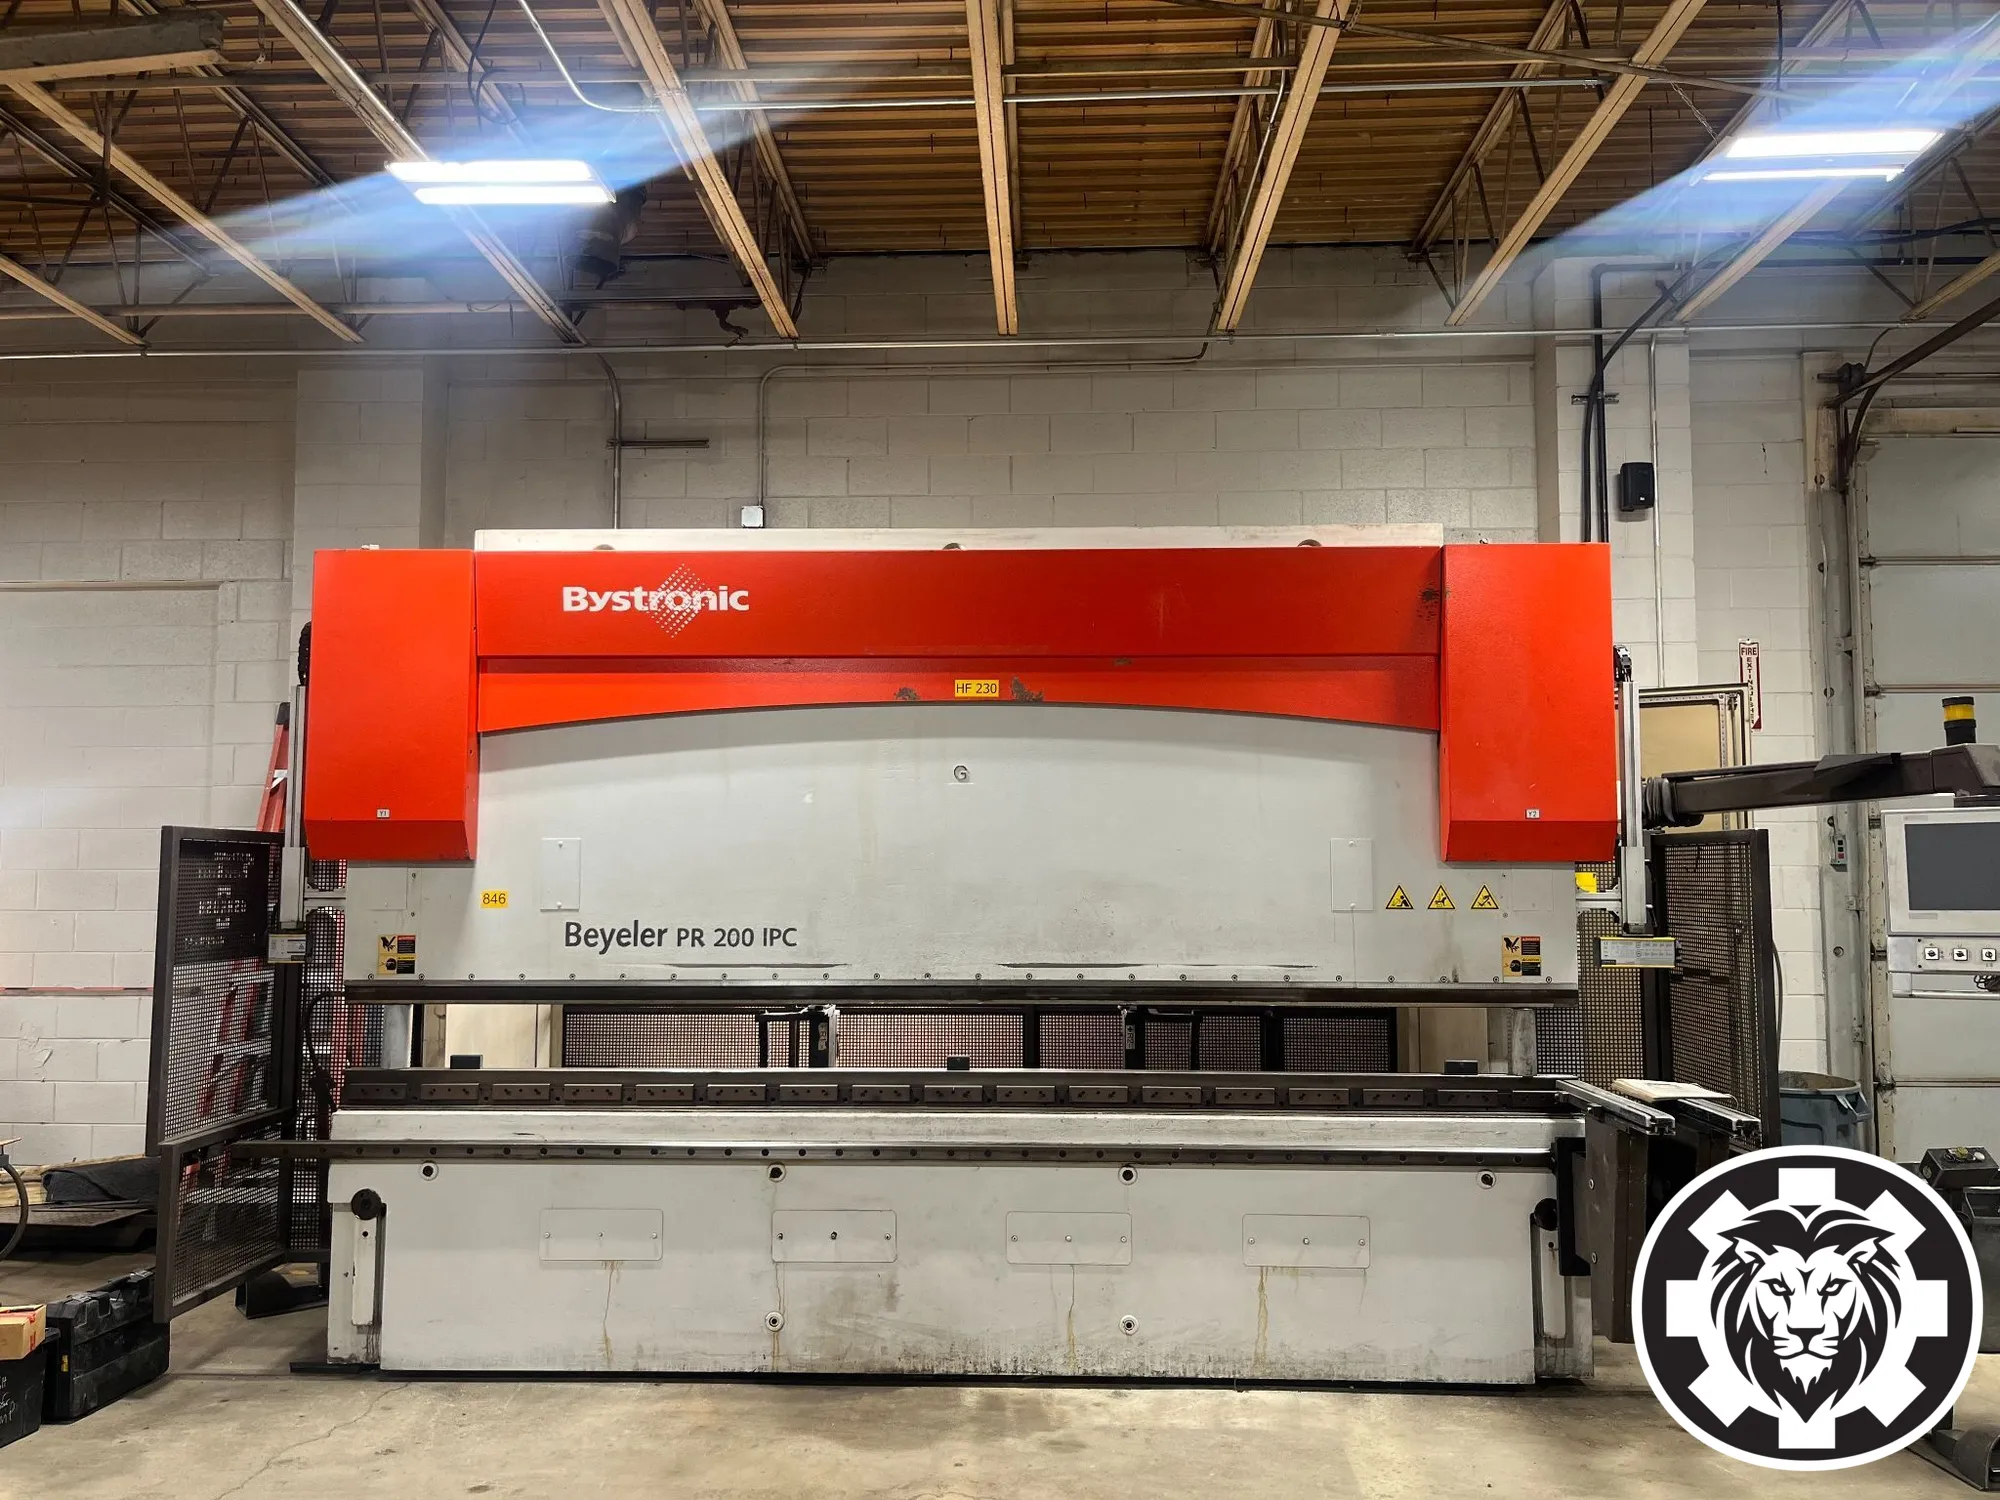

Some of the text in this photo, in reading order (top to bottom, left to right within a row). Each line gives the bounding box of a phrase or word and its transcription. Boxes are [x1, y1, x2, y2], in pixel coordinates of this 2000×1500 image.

[562, 585, 749, 612] Bystronic
[1741, 647, 1757, 656] FIRE
[956, 683, 997, 694] HF 230
[482, 893, 506, 905] 846
[565, 919, 797, 955] Beyeler PR 200 IPC
